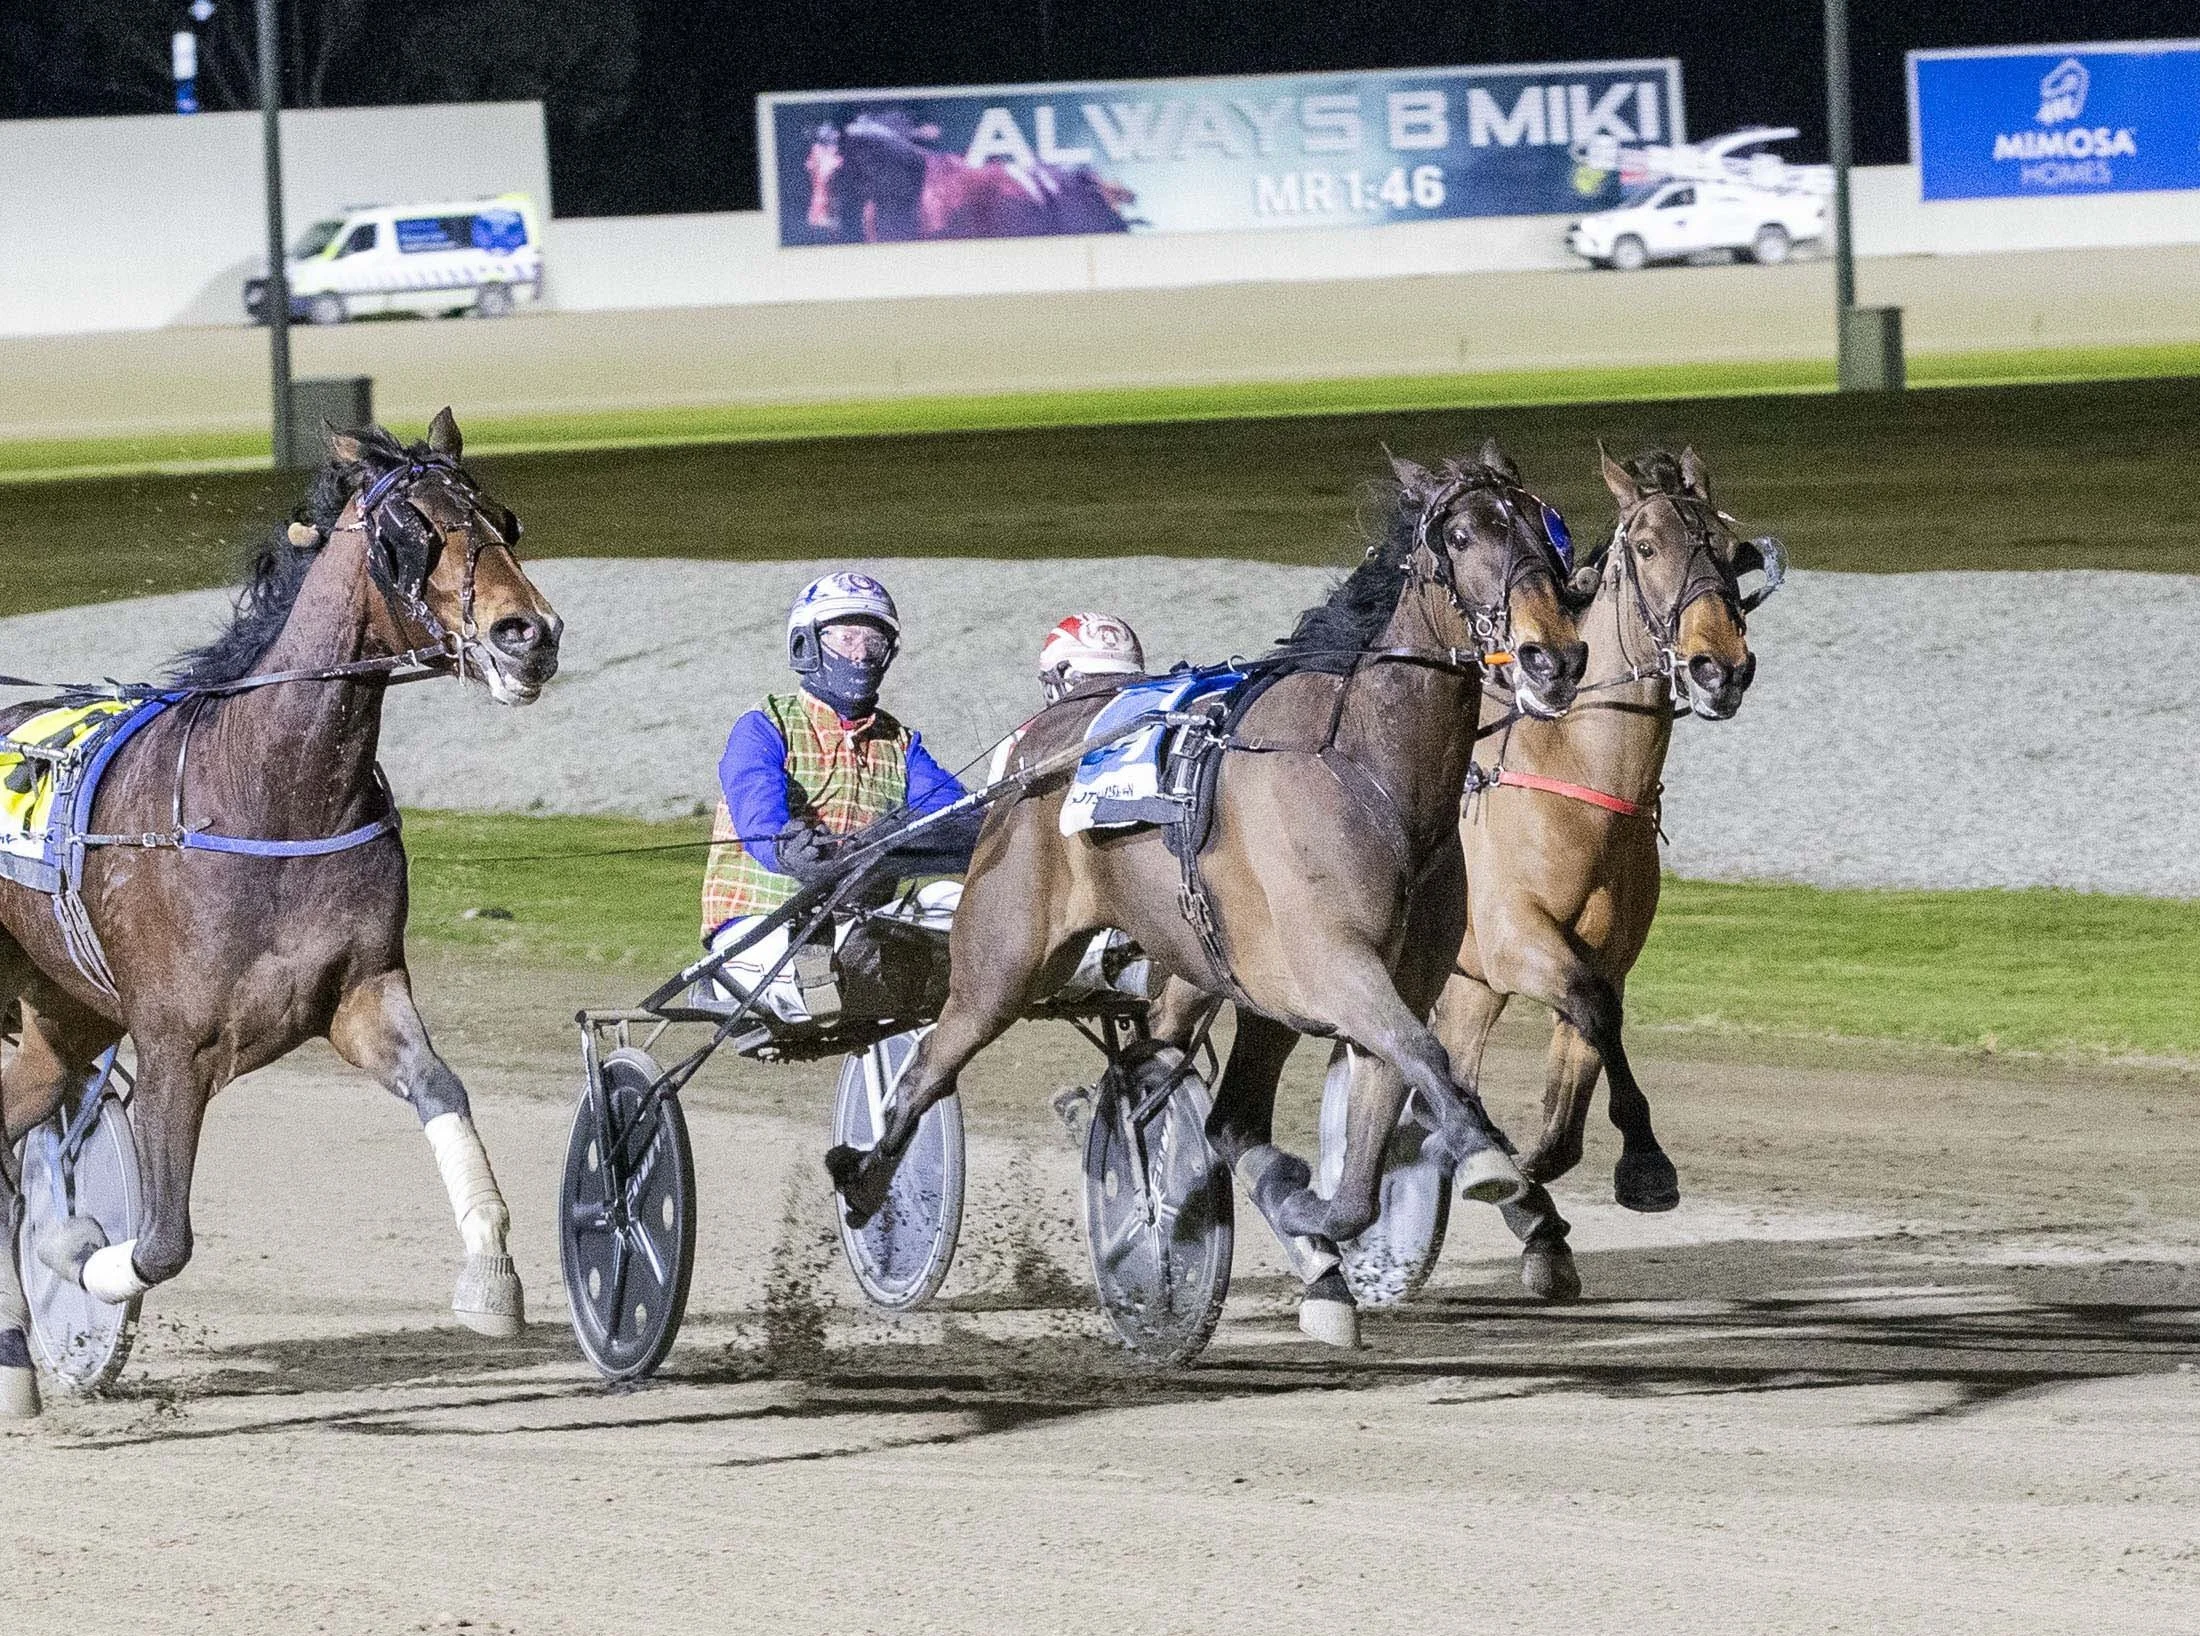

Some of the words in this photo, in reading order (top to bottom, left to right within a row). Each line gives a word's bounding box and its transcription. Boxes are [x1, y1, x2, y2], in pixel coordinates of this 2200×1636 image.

[965, 94, 1363, 170] ALWAYS
[1388, 89, 1449, 150] B
[1466, 81, 1661, 149] MIKI
[1993, 127, 2136, 161] MIMOSA
